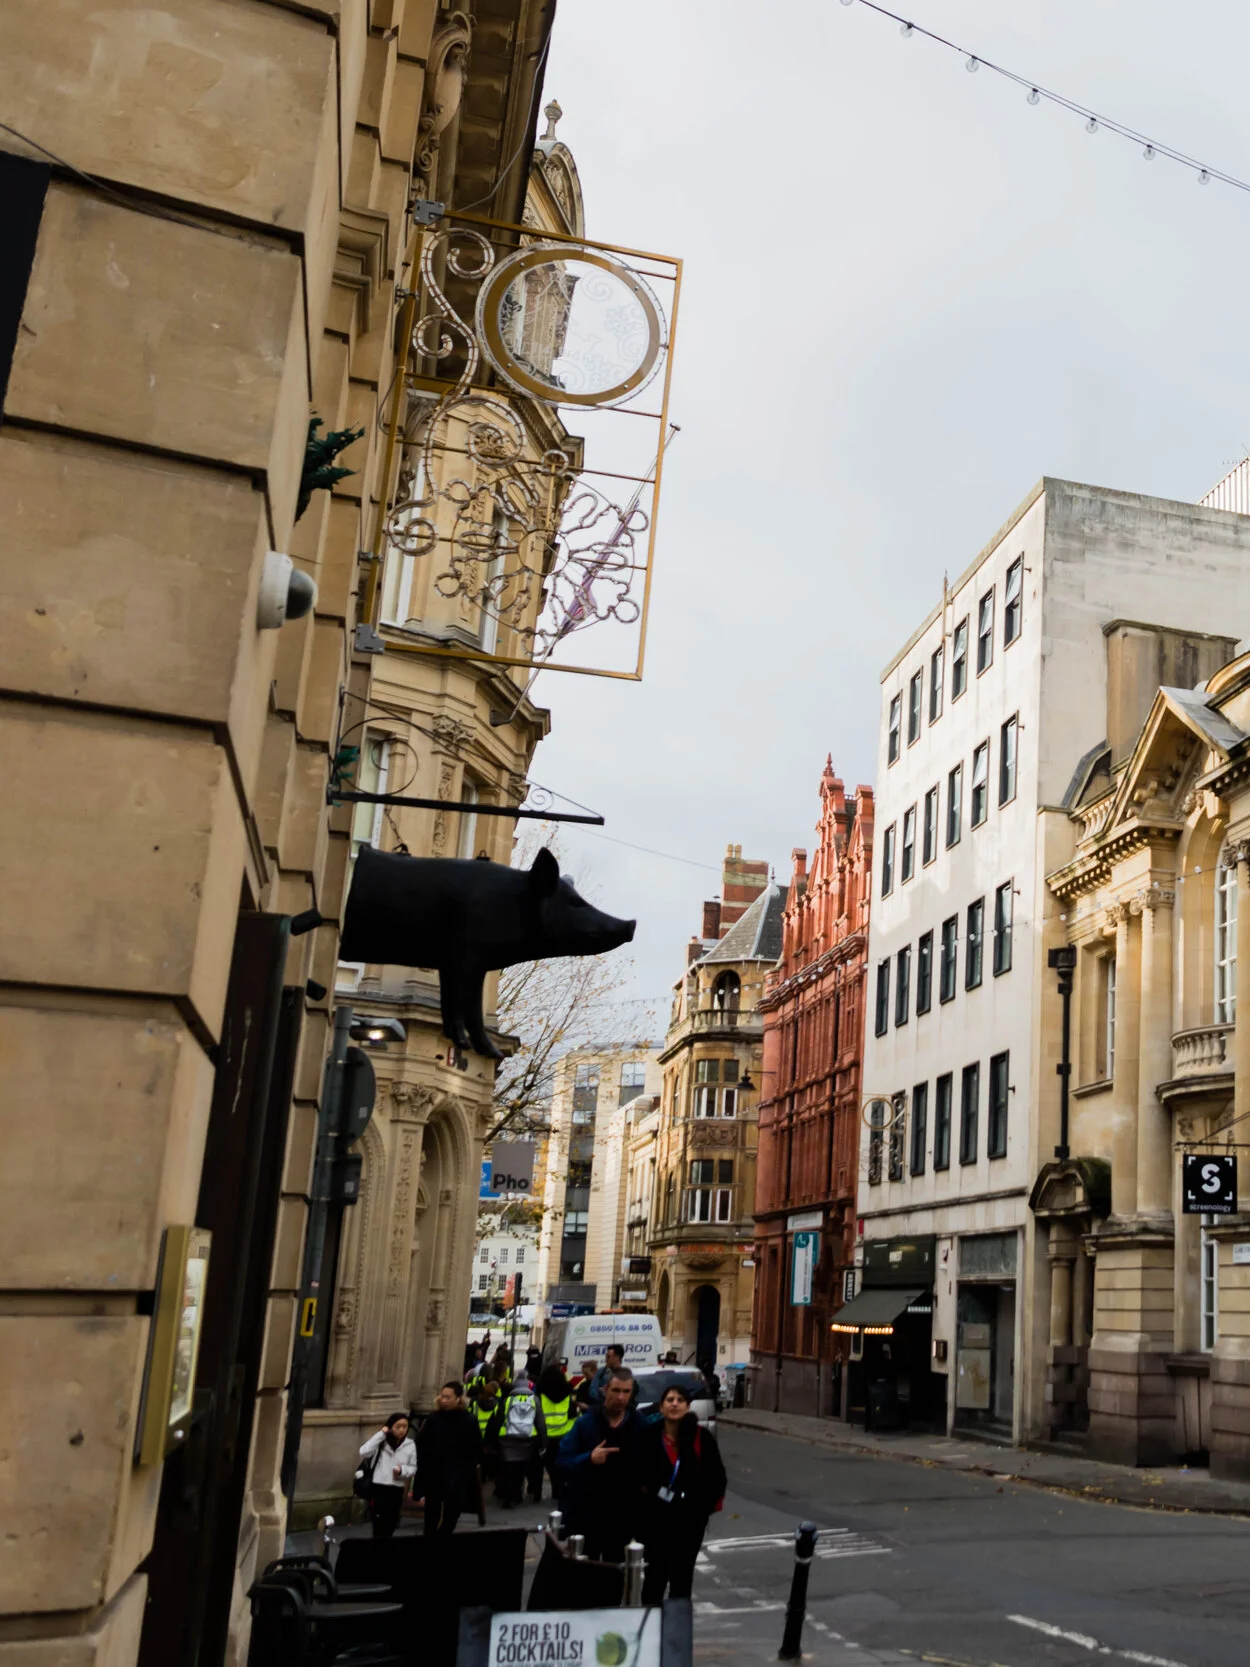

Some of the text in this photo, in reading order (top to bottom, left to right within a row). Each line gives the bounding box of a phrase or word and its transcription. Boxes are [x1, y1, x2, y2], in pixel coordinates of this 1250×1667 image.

[493, 1173, 530, 1190] Pho
[1189, 1202, 1232, 1213] screenology
[625, 1343, 652, 1353] ROD
[499, 1621, 570, 1642] 2 FOR £10
[496, 1640, 584, 1664] COCKTAILS!
